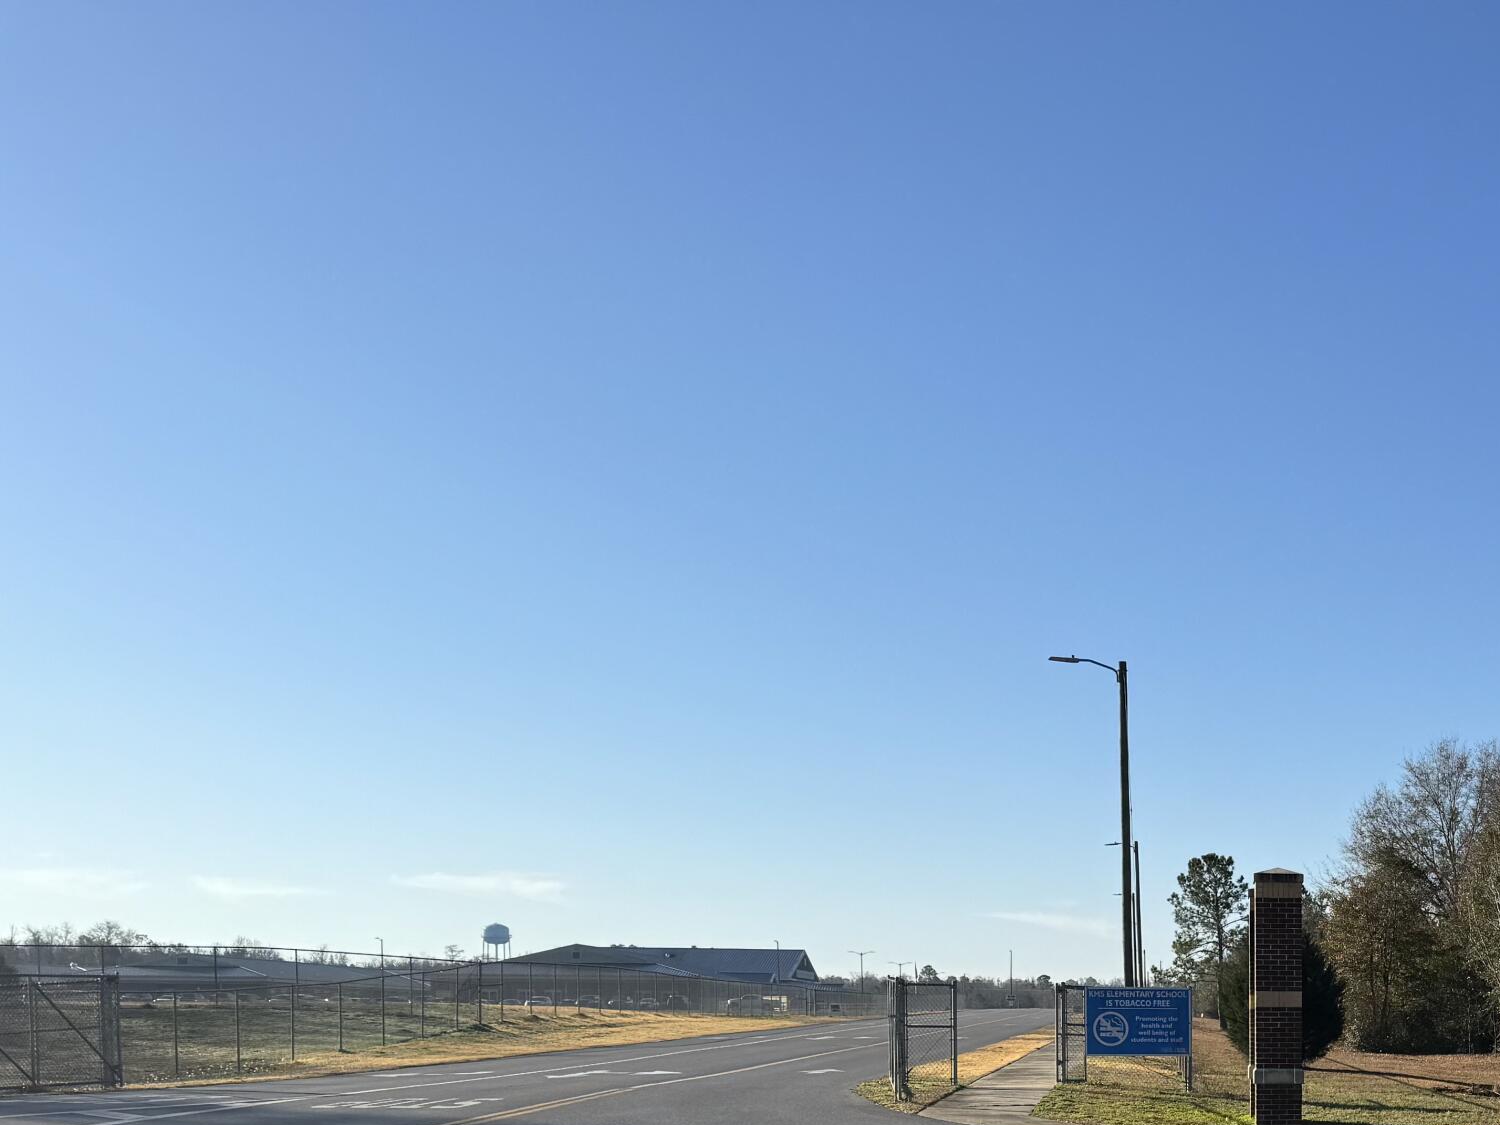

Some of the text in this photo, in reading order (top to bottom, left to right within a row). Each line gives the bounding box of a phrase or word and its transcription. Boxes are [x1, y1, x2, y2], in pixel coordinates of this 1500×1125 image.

[1106, 990, 1154, 998] ELEMENTARY
[1156, 990, 1187, 998] SCHOOL
[1105, 999, 1171, 1007] IS TOBACCO FREE
[1135, 1015, 1167, 1023] Promoting
